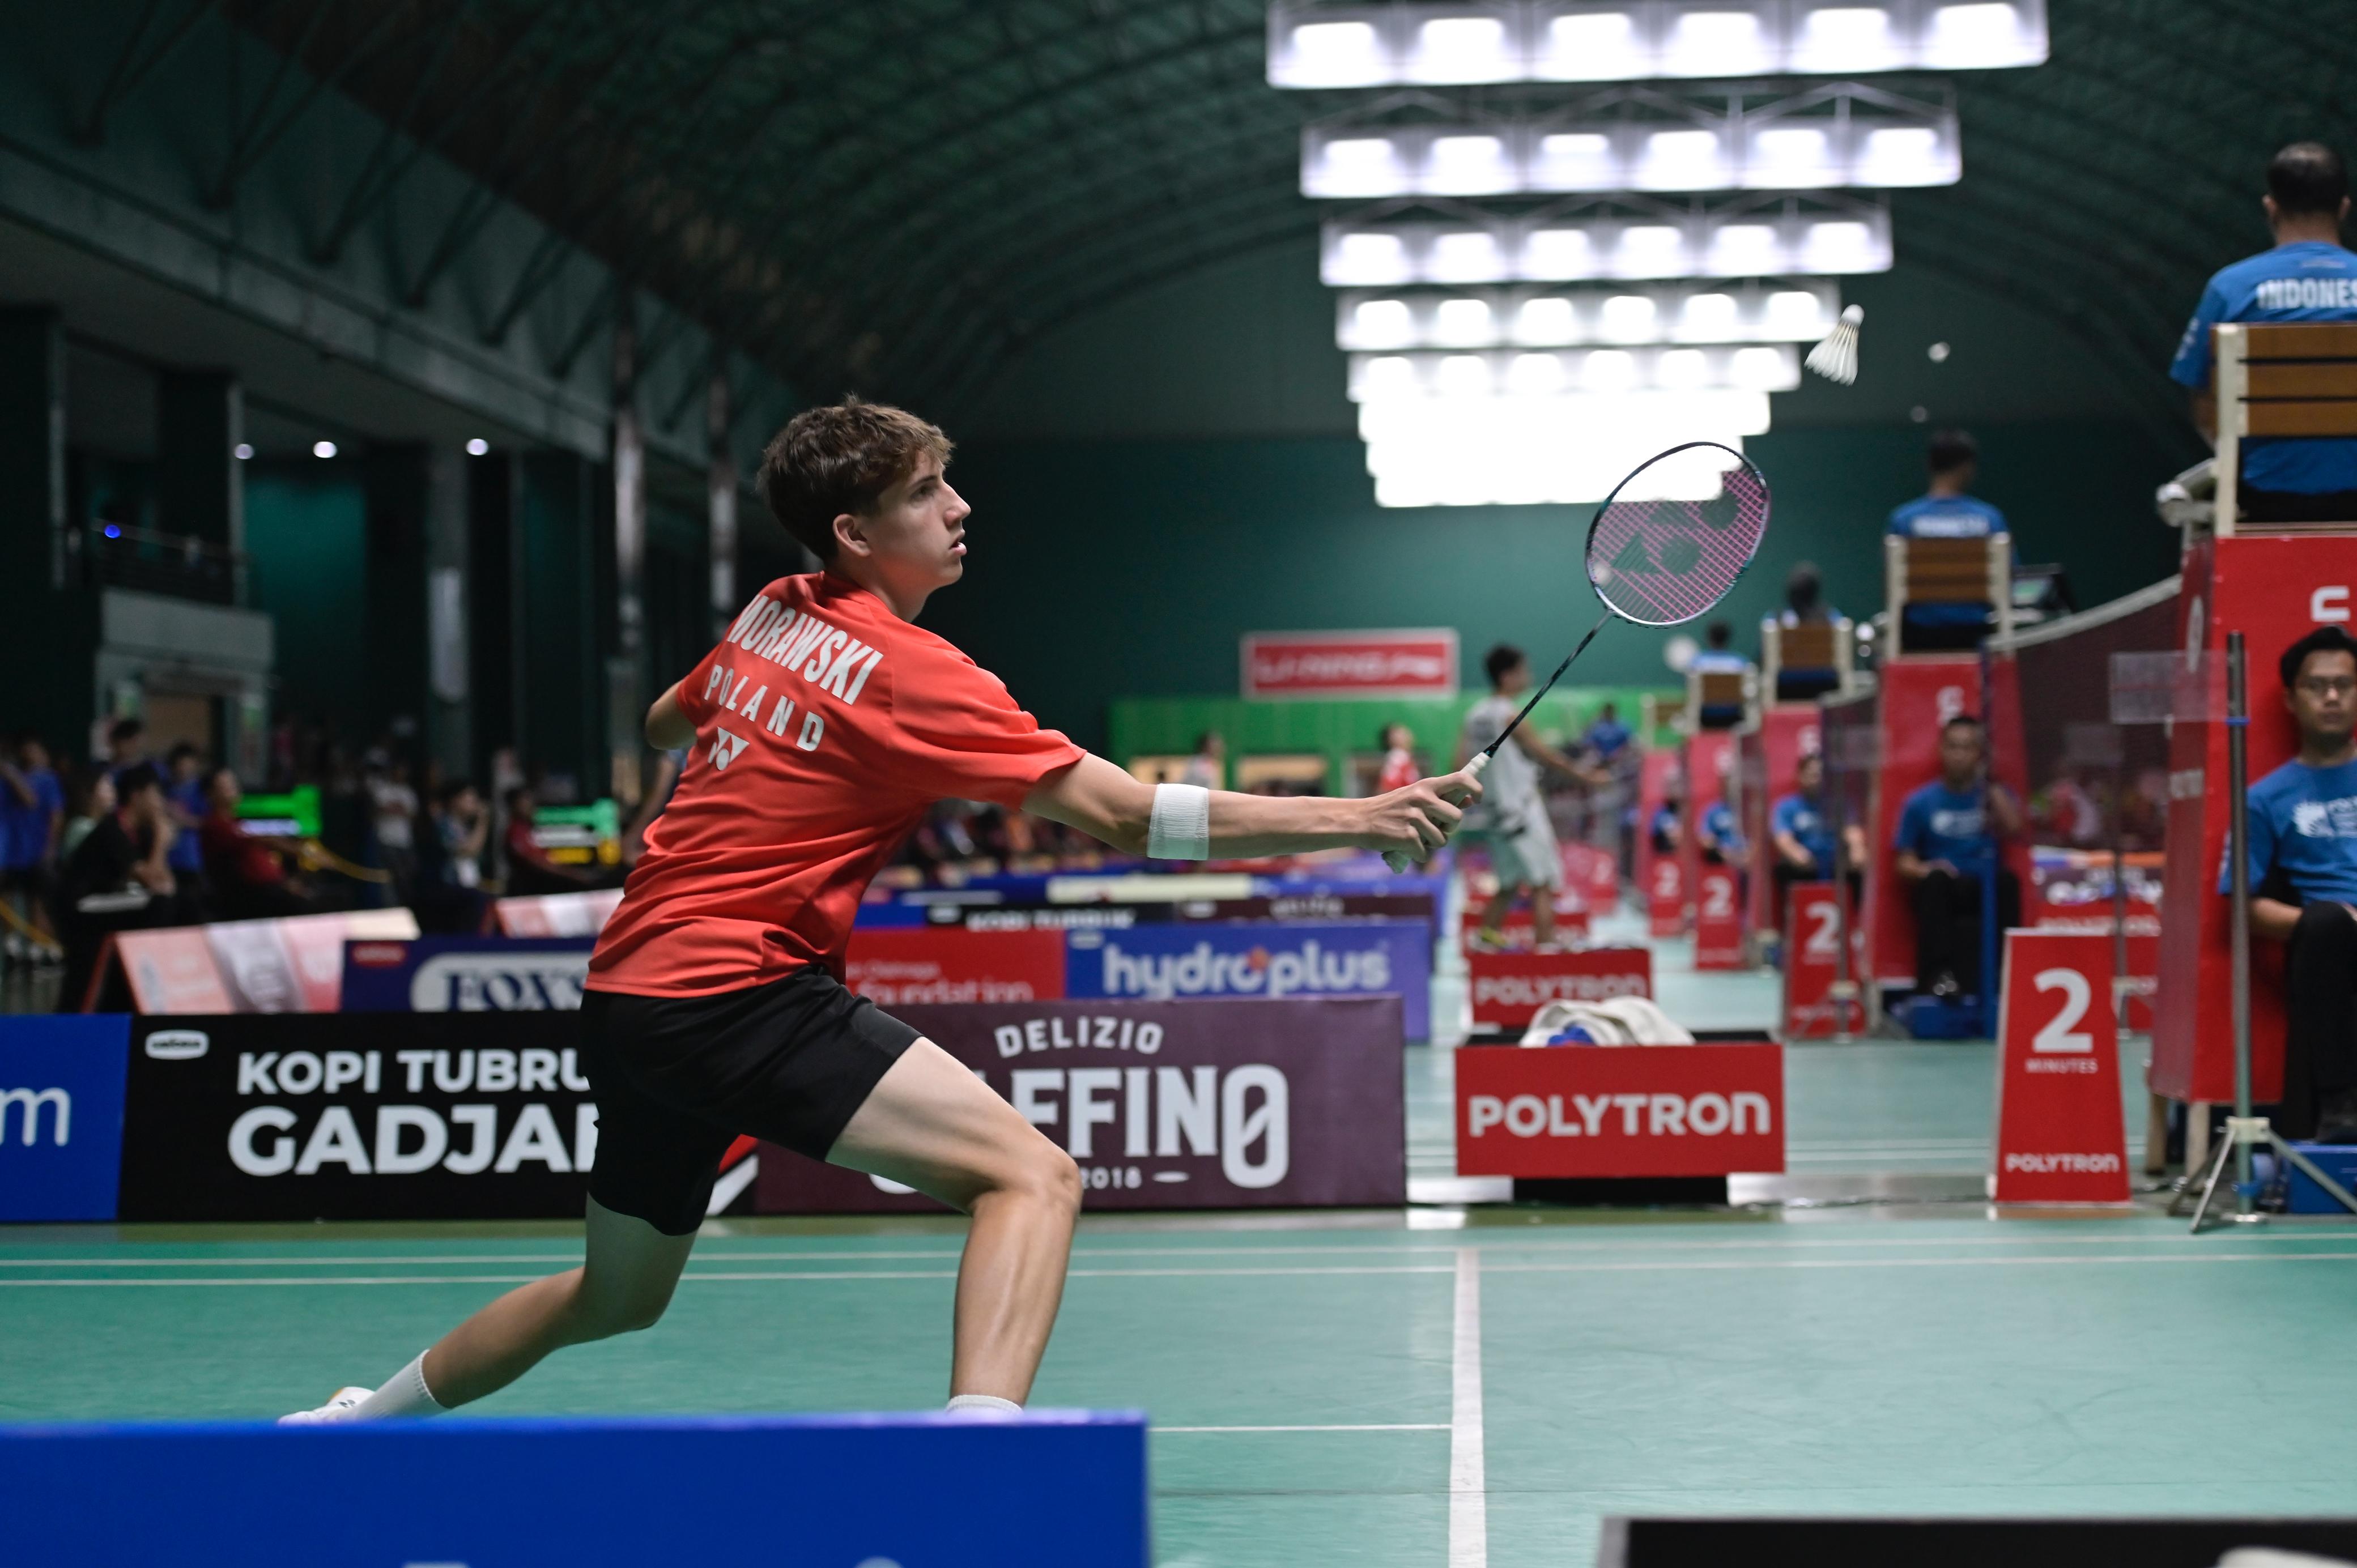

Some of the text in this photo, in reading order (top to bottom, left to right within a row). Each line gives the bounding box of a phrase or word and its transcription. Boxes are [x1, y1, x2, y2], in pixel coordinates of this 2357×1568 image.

[704, 664, 824, 752] POLAND
[1703, 876, 1733, 917] 2
[1102, 940, 1391, 1000] hydroplus
[2032, 968, 2094, 1053] 2
[994, 1016, 1163, 1058] DELIZIO
[237, 1051, 380, 1094] KOPI
[2025, 1058, 2099, 1073] MINUTES
[868, 1064, 1289, 1194] FFINO
[1469, 1092, 1771, 1137] POLYTRON
[2005, 1152, 2120, 1173] POLYTRON
